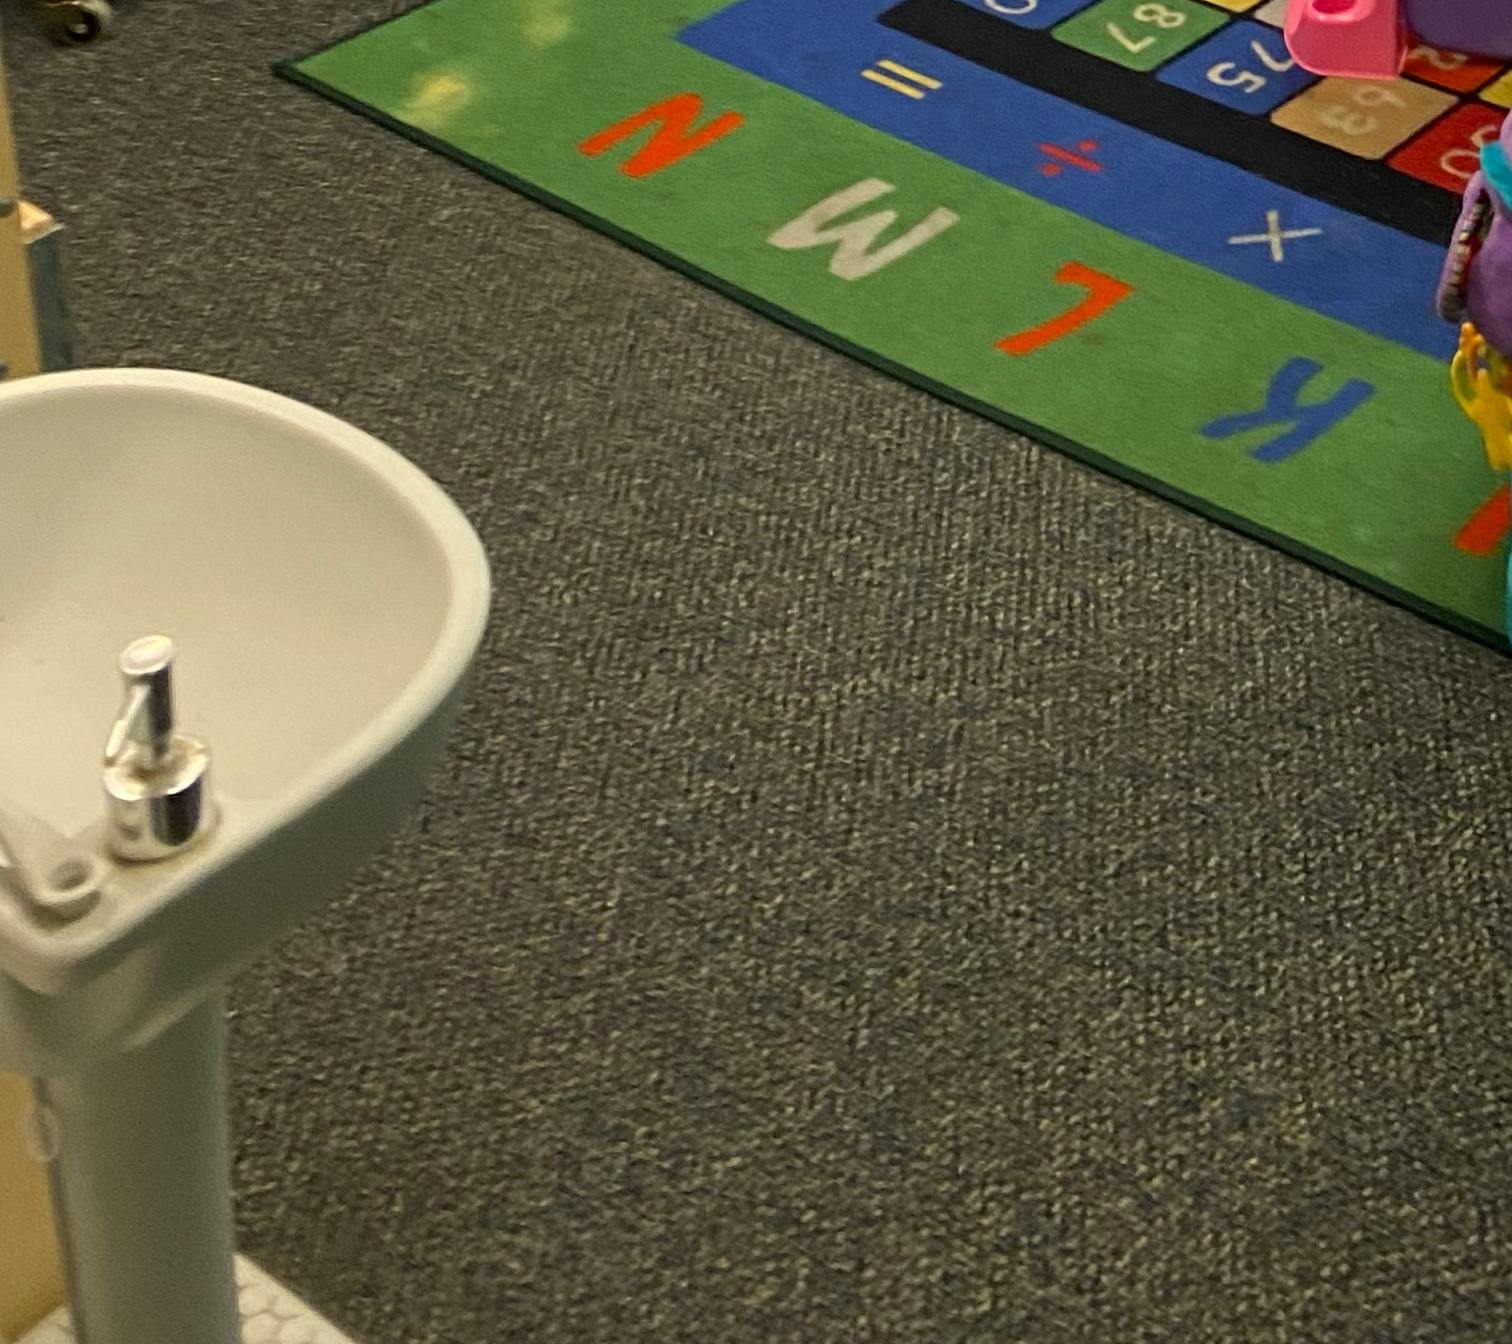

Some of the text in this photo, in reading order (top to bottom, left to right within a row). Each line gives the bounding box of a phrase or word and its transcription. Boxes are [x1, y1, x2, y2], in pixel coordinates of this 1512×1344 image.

[1106, 3, 1186, 54] 87
[1206, 40, 1293, 94] 75
[577, 92, 745, 179] N
[994, 260, 1134, 356] L
[1196, 356, 1377, 463] K
